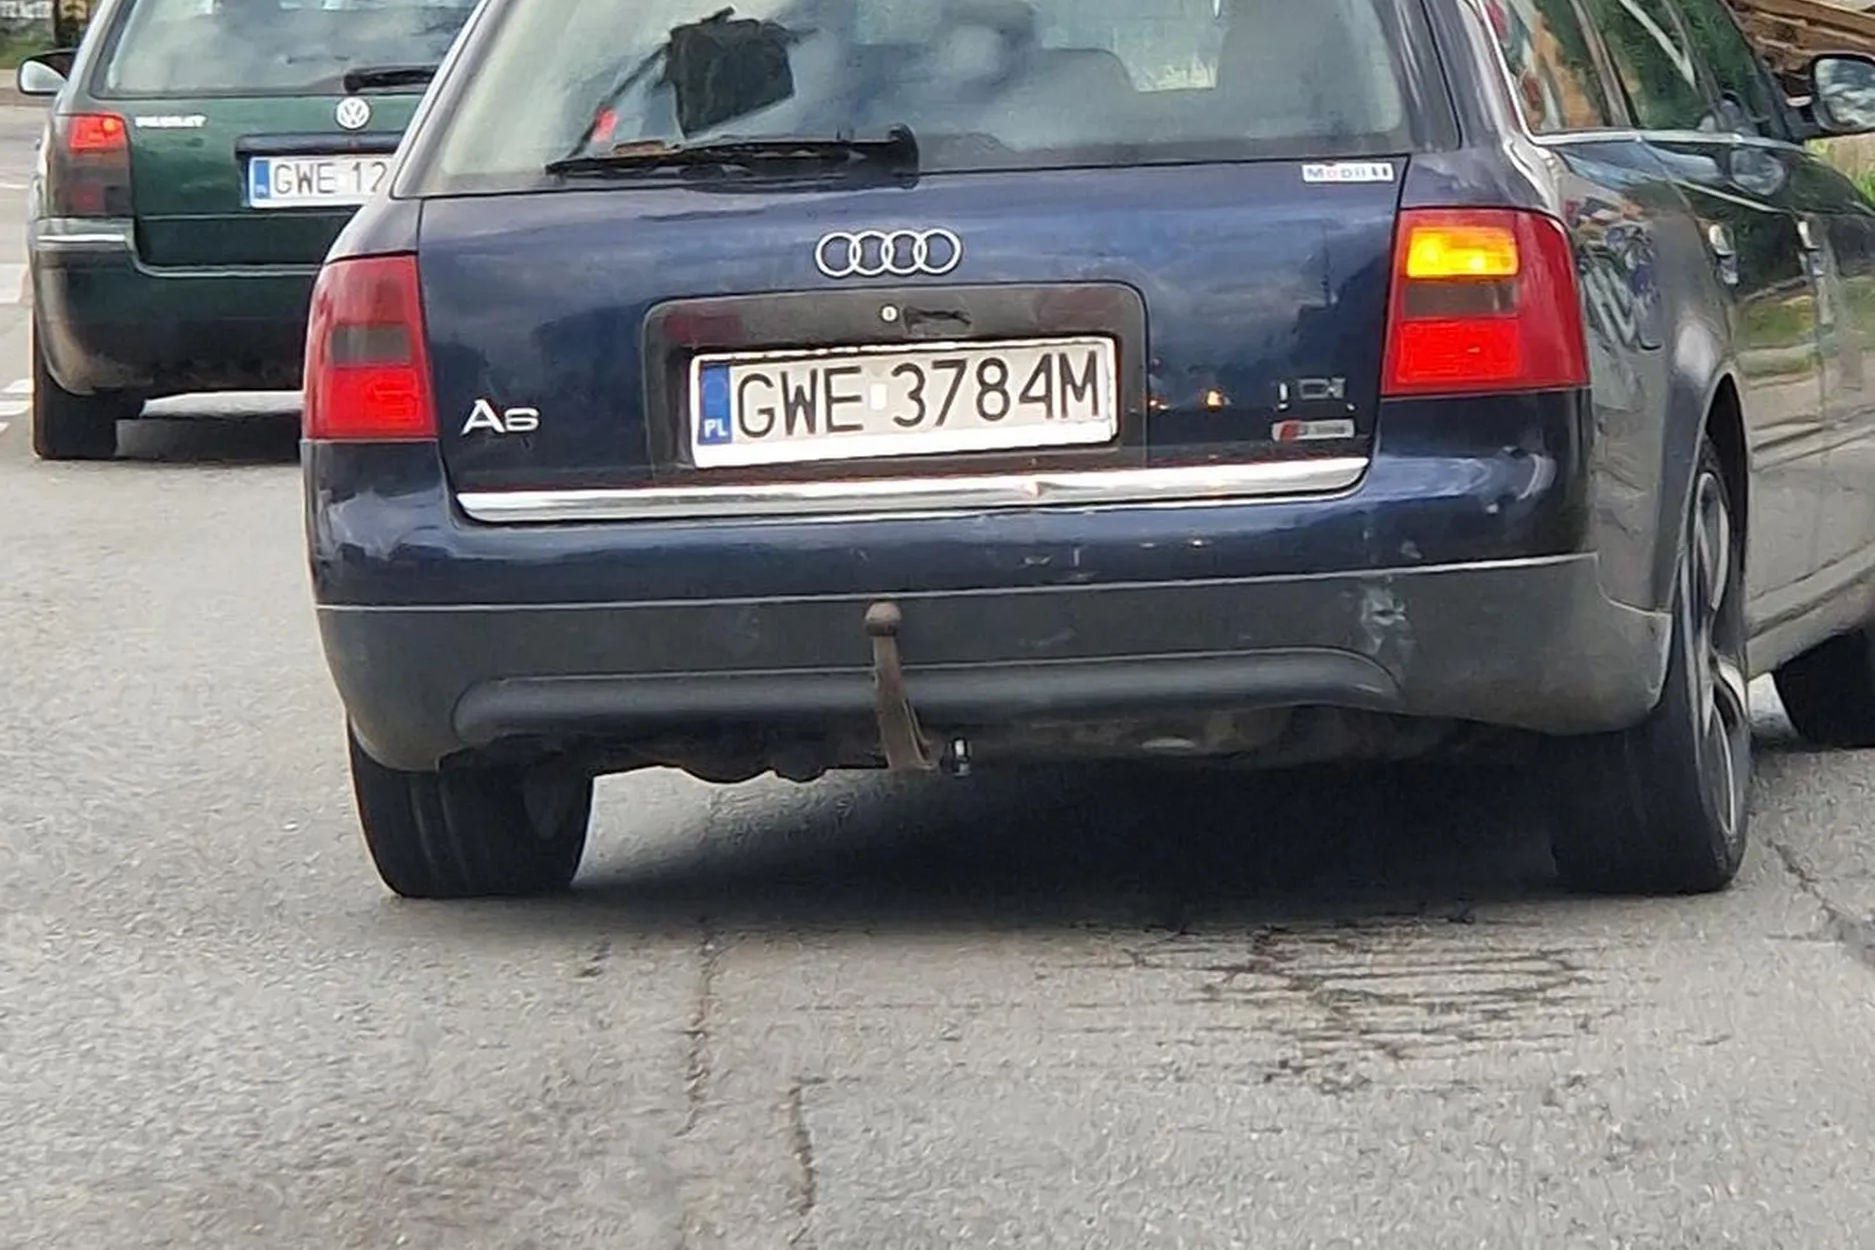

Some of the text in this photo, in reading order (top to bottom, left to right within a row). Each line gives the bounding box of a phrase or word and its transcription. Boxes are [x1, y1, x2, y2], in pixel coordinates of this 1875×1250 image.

[274, 162, 336, 195] GWE
[703, 351, 1100, 439] PL GWE 3784M
[461, 399, 540, 436] A6
